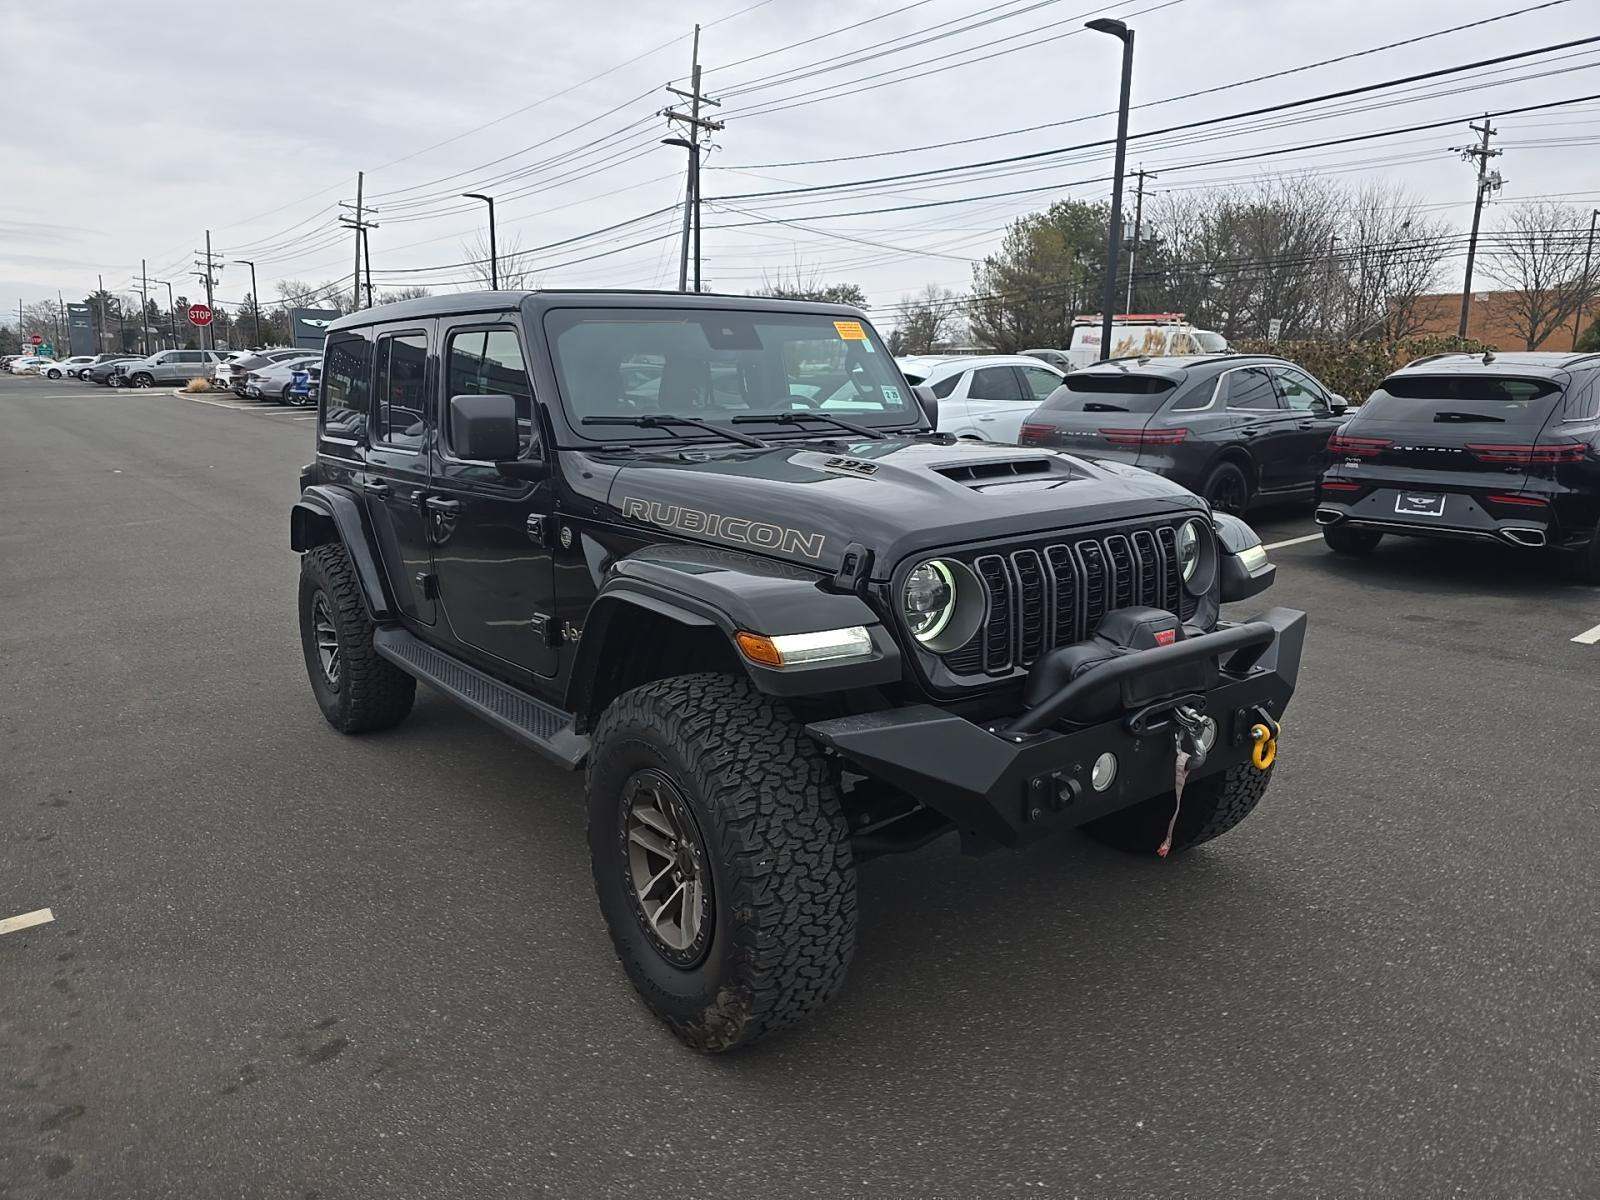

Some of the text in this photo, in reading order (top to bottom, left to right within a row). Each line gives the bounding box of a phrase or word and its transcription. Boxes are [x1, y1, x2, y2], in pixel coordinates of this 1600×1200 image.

[190, 310, 210, 319] STOP
[825, 457, 880, 475] 392
[622, 496, 825, 559] RUBICON
